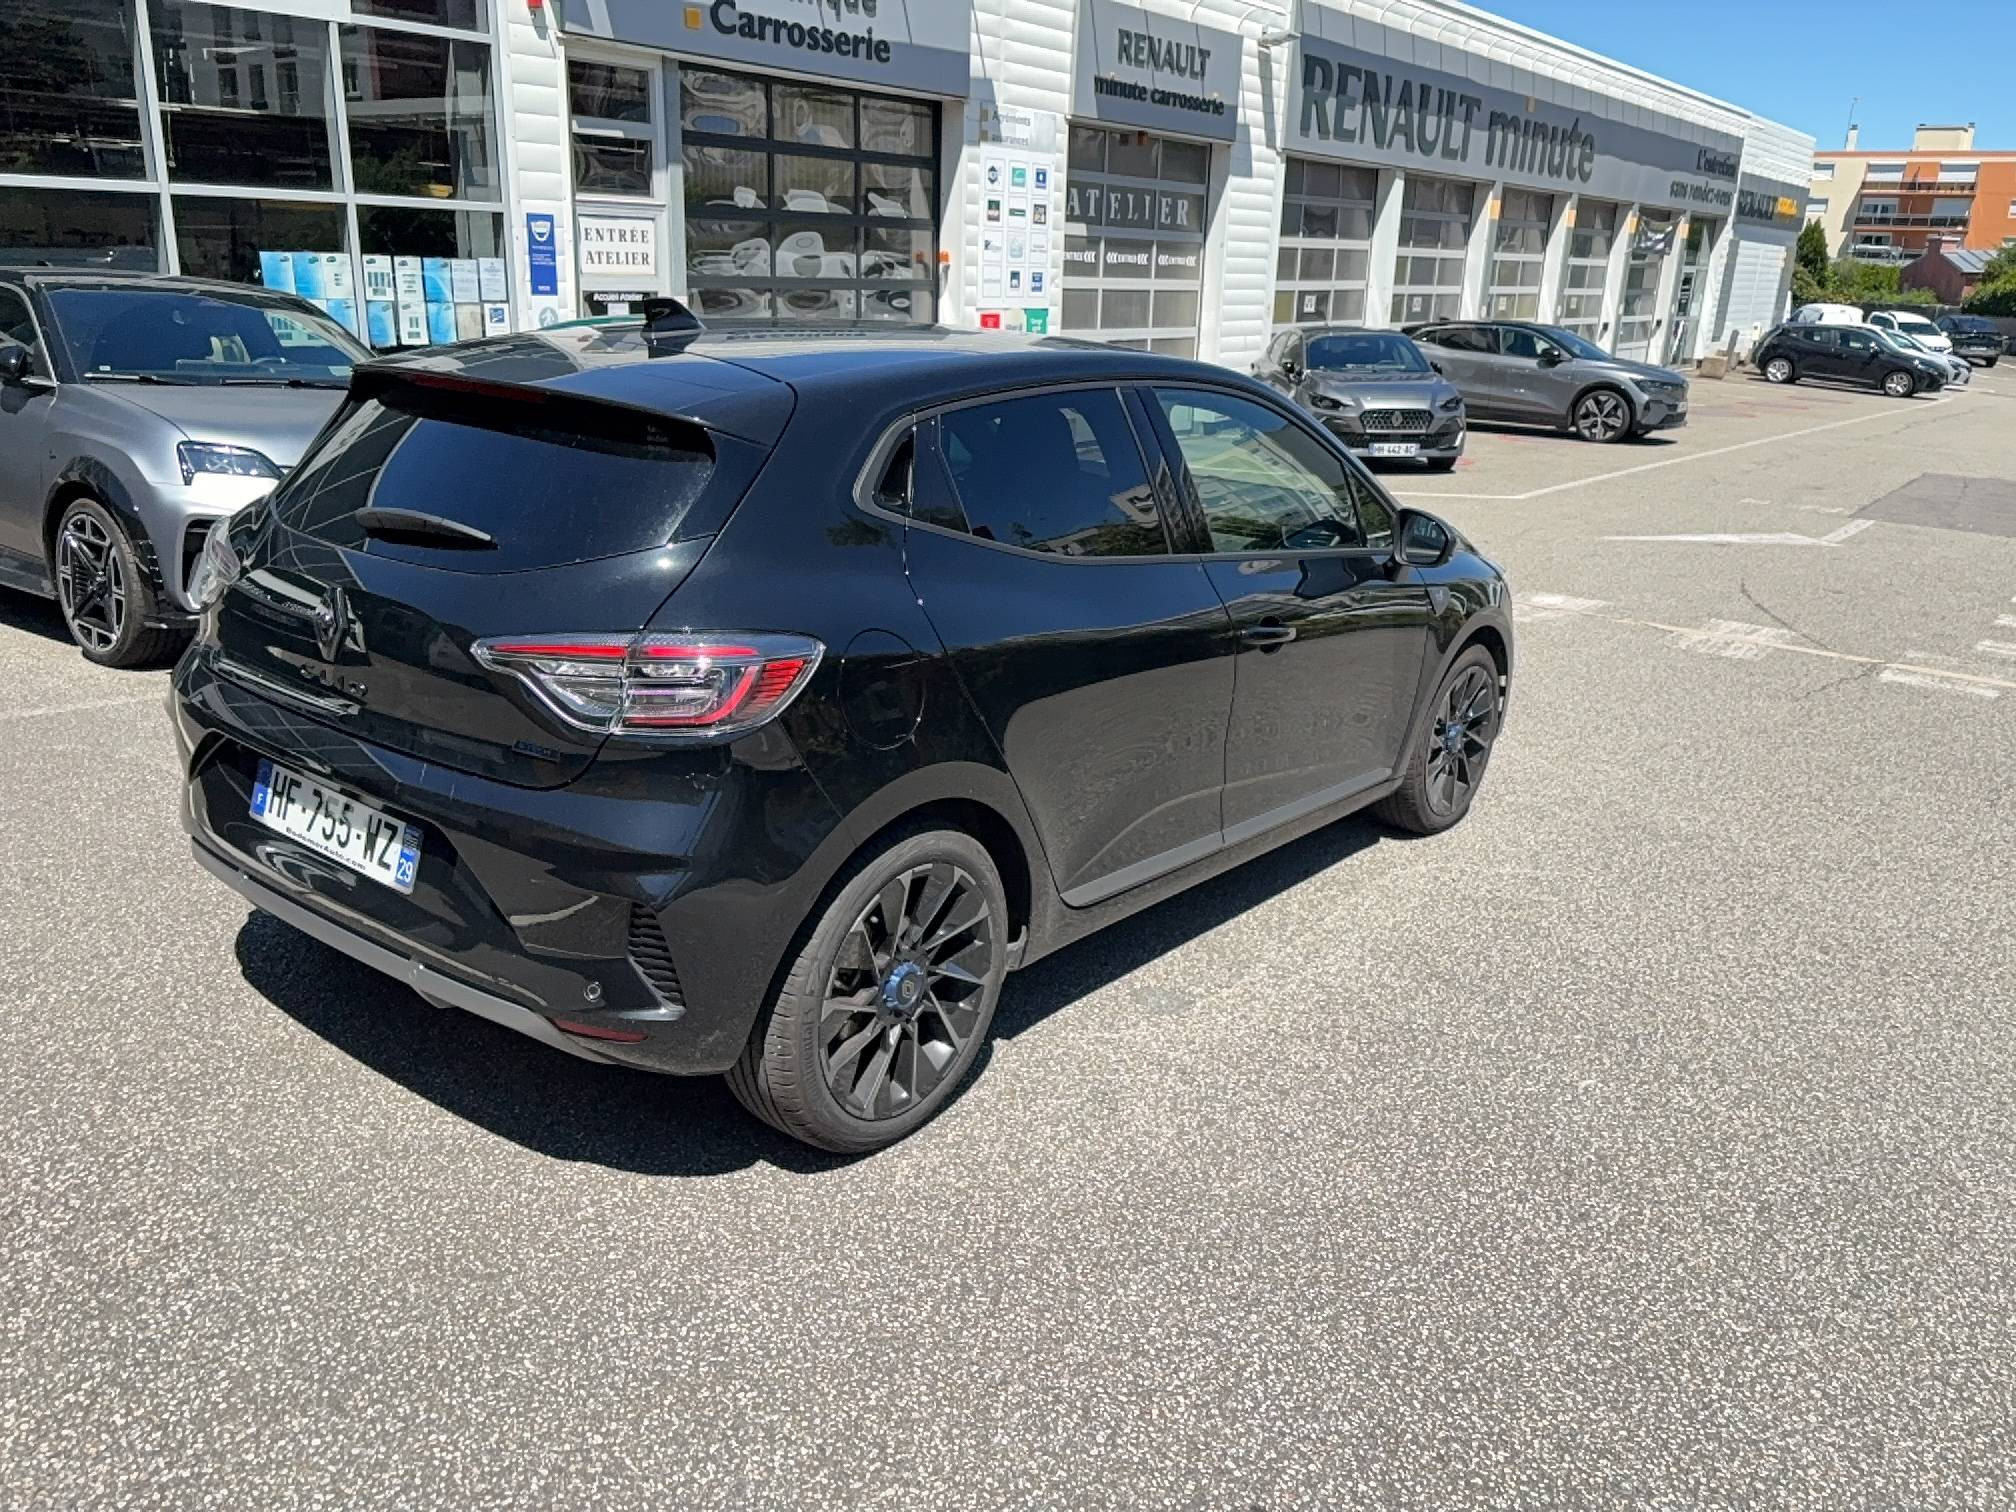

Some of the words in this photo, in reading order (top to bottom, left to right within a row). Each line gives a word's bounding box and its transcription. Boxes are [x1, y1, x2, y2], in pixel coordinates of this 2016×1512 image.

[710, 0, 891, 63] Carrosserie
[1117, 28, 1210, 80] RENAULT
[1094, 75, 1147, 101] minute
[1151, 87, 1224, 116] carrosserie
[1300, 53, 1482, 163] RENAULT
[1485, 108, 1595, 183] minute
[1066, 187, 1189, 225] ATELIER
[584, 226, 649, 243] ENTRÉE
[585, 250, 650, 265] ATELIER
[397, 857, 414, 884] 29
